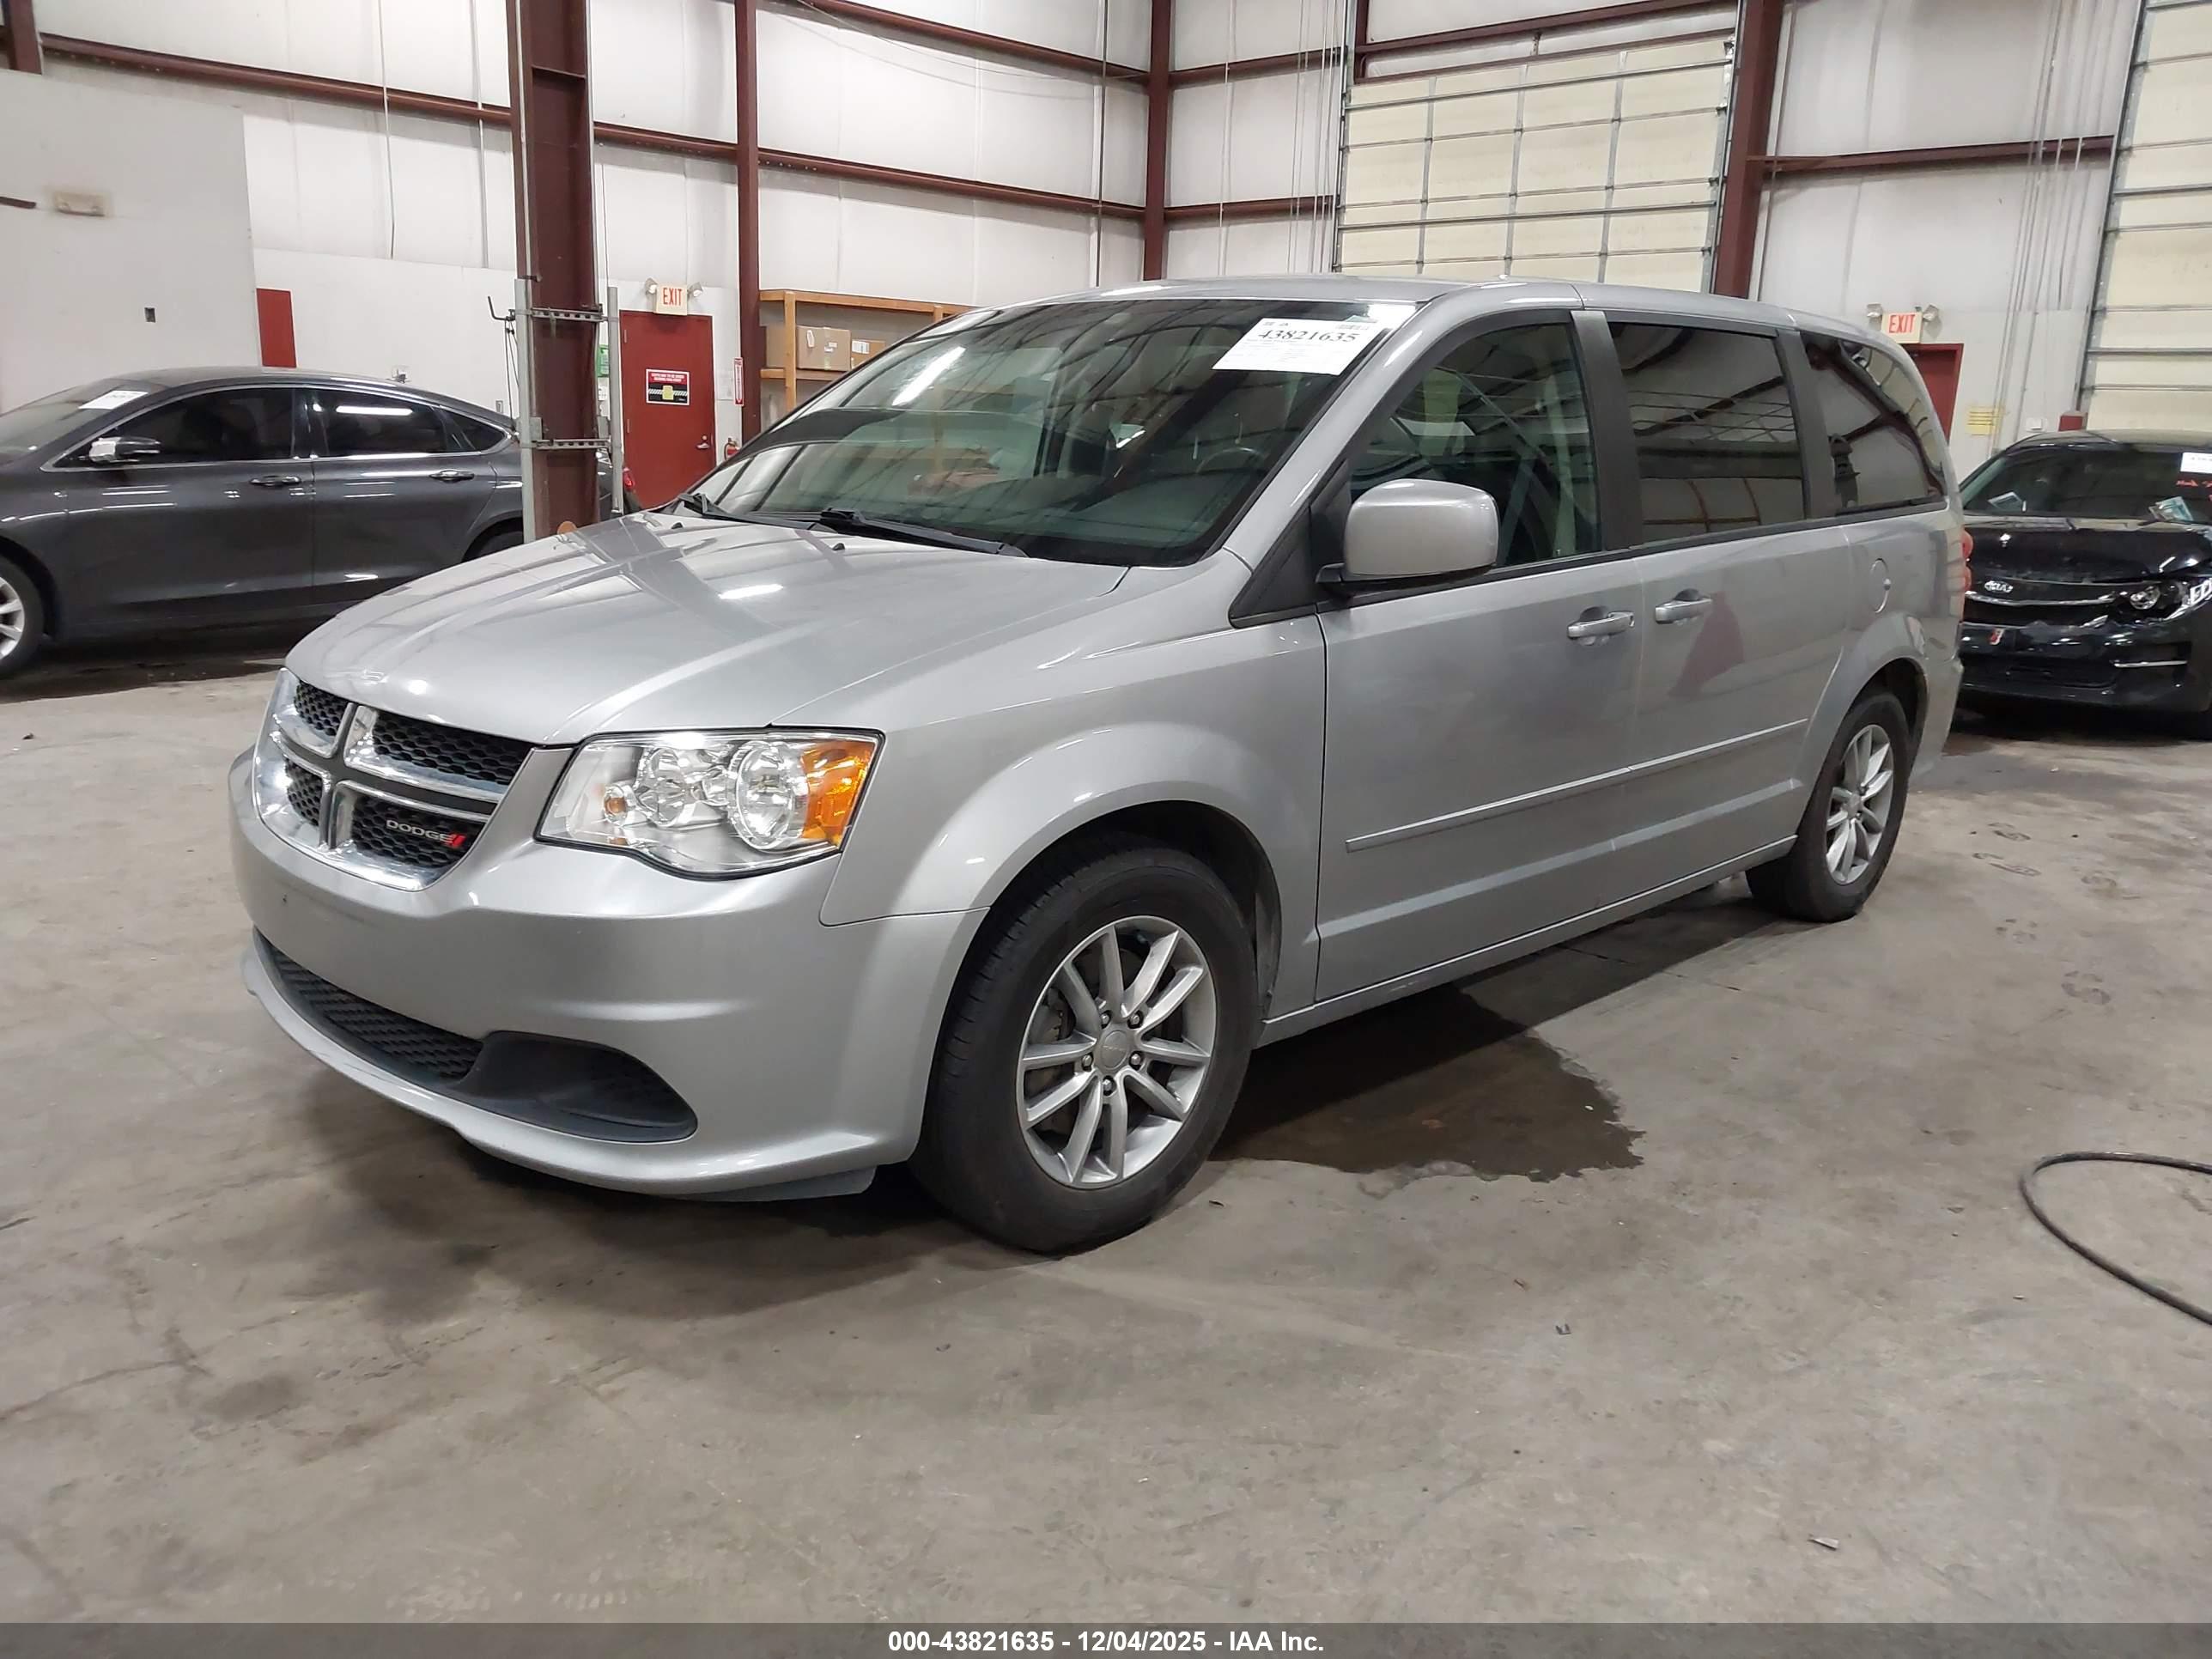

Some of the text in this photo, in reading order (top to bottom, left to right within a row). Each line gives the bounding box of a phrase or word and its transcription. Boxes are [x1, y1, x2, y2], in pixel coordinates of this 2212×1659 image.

[663, 288, 683, 306] EXIT
[1888, 314, 1916, 333] EXIT
[1258, 329, 1360, 343] 43821635
[386, 819, 453, 844] DODGE
